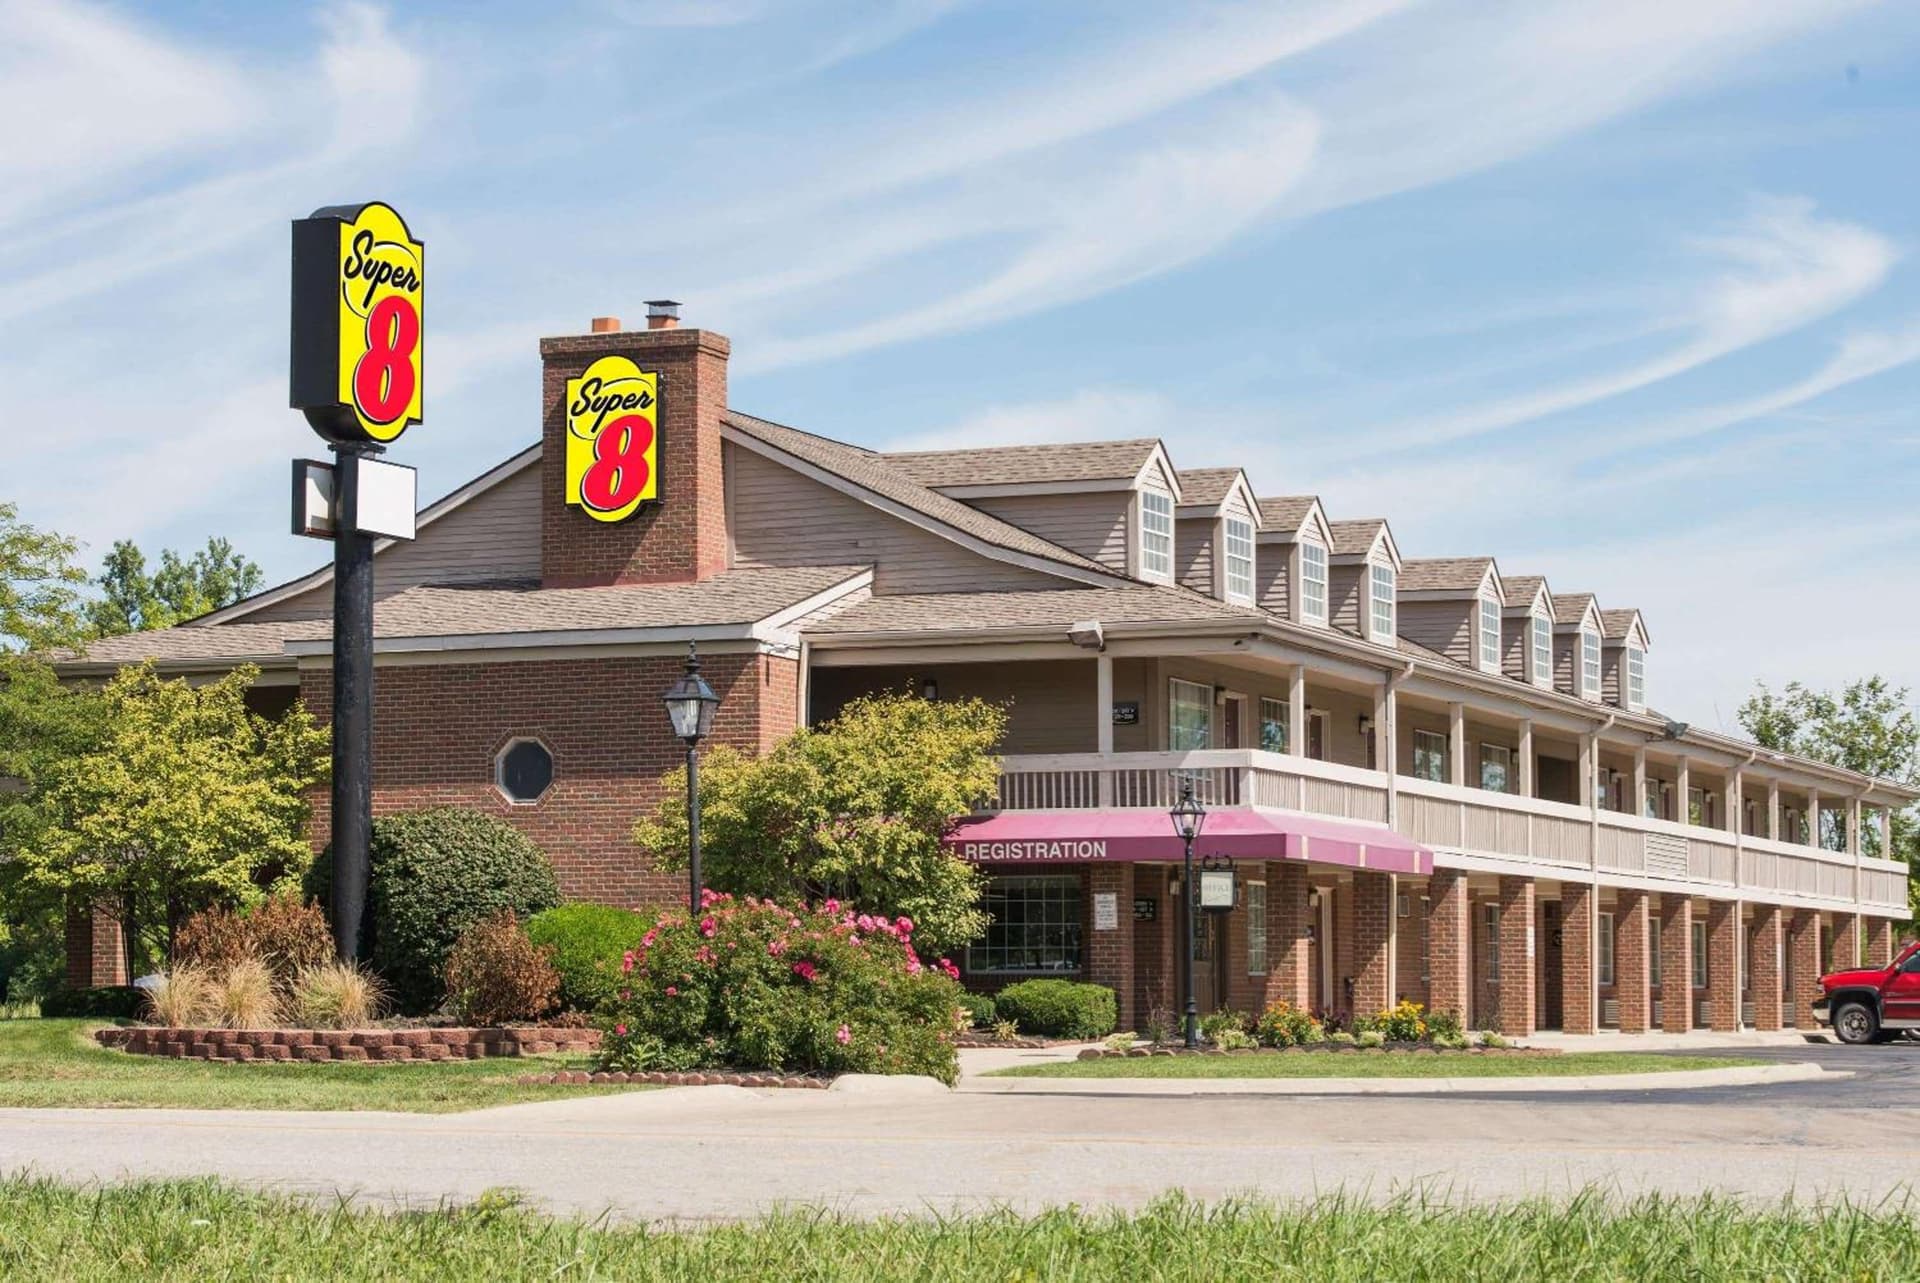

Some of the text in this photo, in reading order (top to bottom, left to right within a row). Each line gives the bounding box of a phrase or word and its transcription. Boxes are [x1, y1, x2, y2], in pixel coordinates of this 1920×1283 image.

[344, 229, 420, 309] Super
[353, 296, 419, 424] 8
[570, 377, 654, 433] Super
[580, 414, 654, 512] 8
[965, 841, 1106, 860] REGISTRATION
